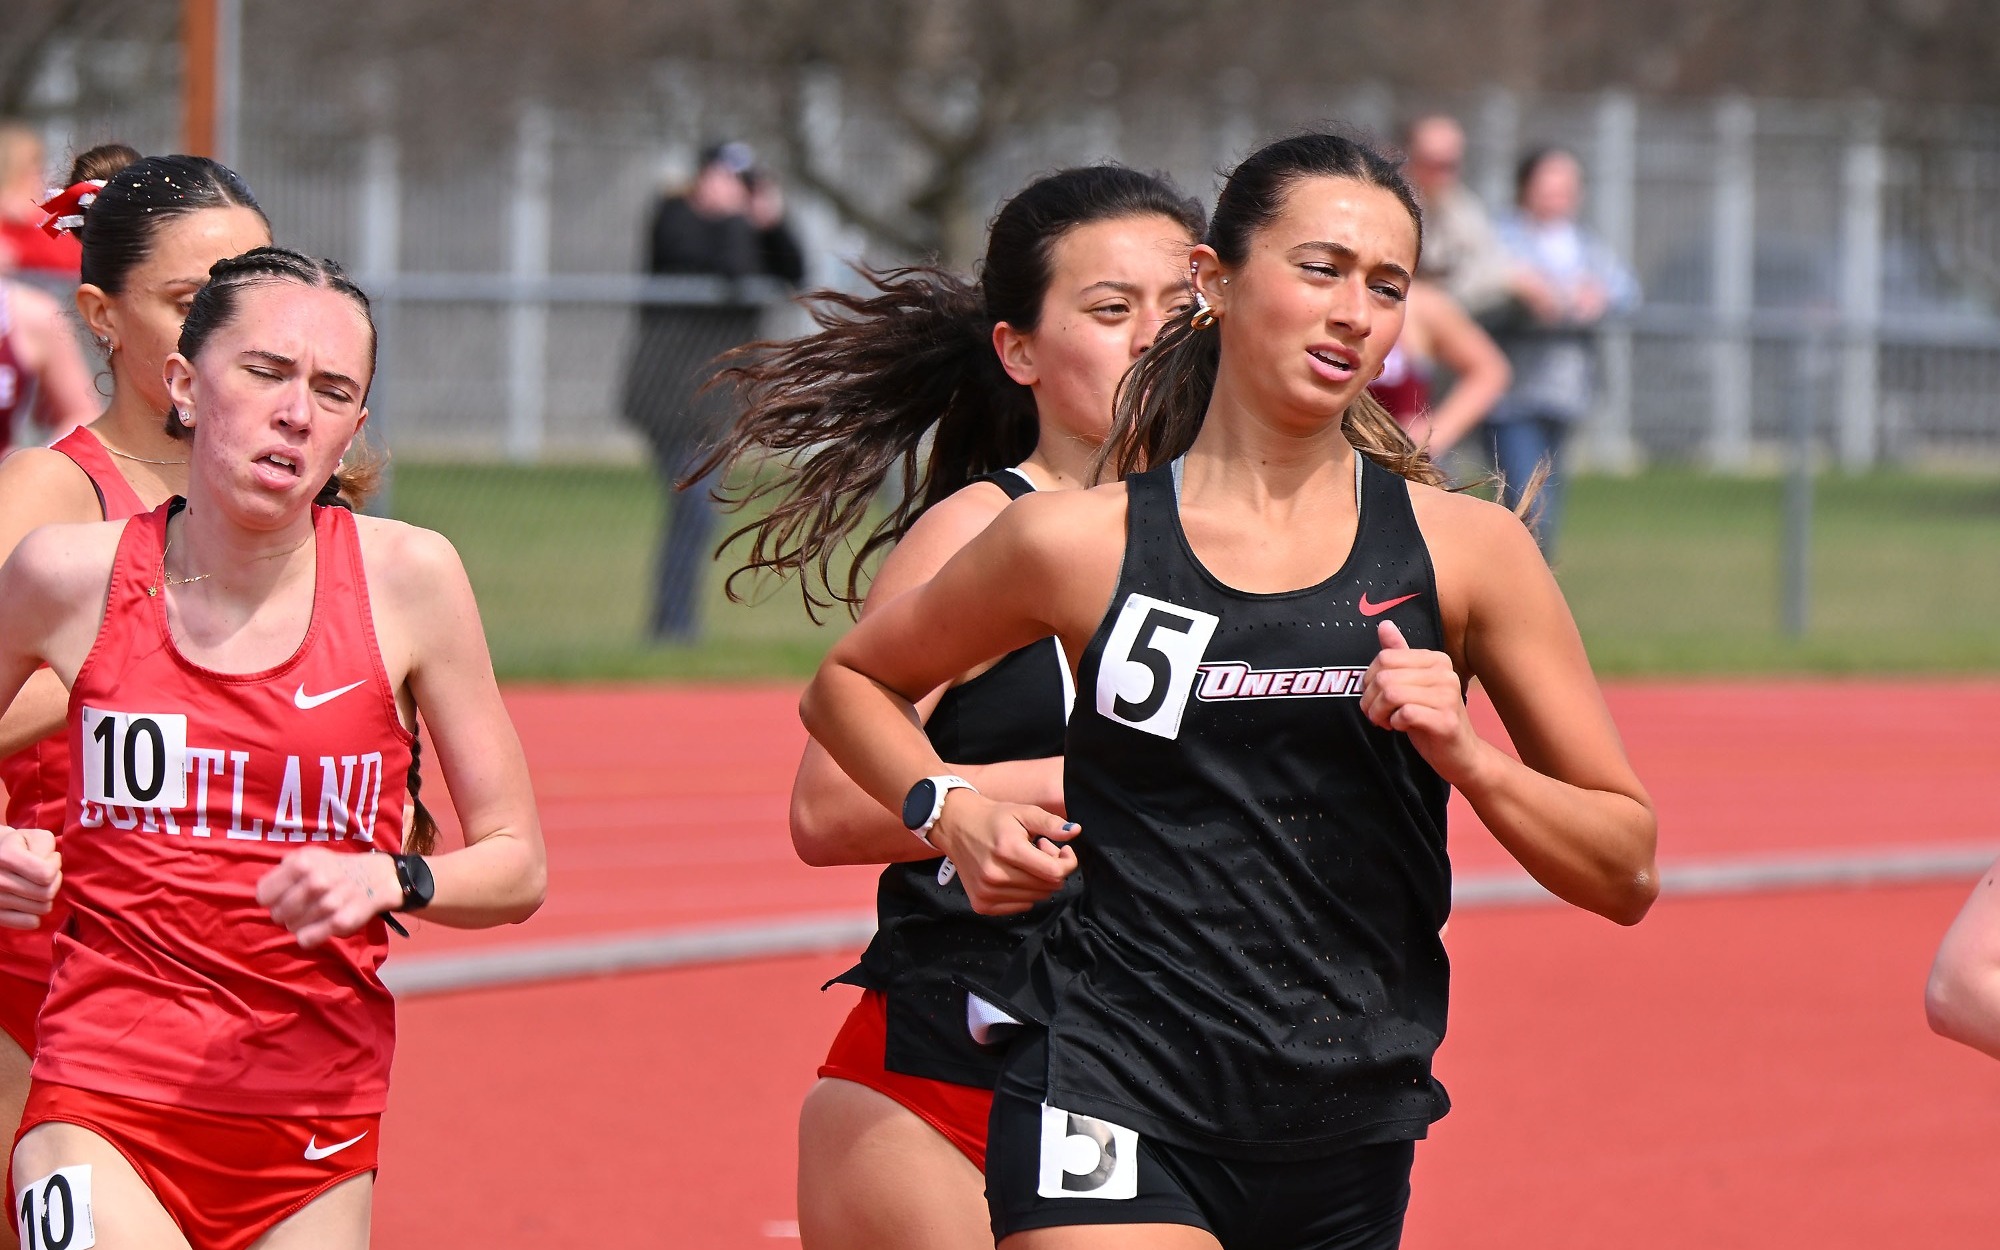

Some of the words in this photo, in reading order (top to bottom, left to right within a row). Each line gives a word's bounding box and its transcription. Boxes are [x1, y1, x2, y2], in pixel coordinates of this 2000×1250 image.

[1112, 607, 1194, 723] 5
[1198, 665, 1366, 698] ONEONT
[93, 715, 166, 802] 10
[20, 1173, 75, 1250] 10
